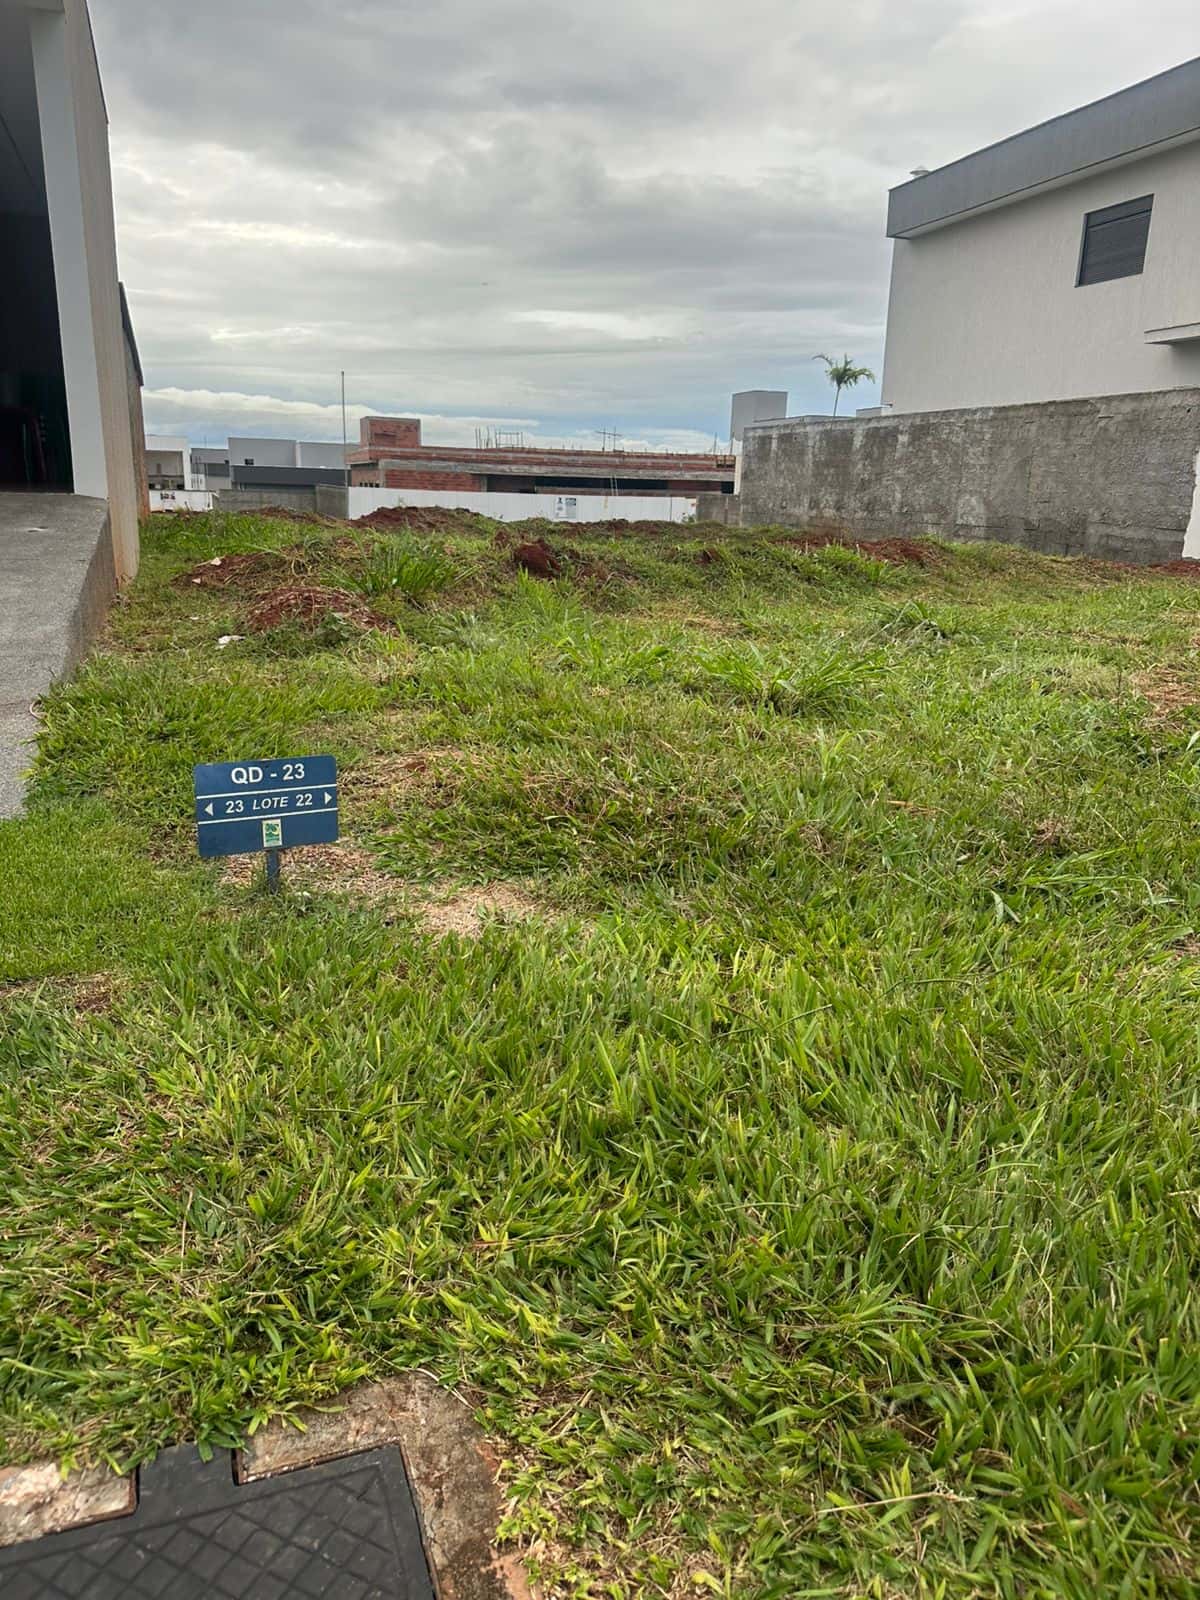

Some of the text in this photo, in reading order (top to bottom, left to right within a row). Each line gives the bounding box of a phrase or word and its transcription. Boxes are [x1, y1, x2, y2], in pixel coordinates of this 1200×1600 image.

[231, 767, 263, 784] QD
[282, 764, 305, 781] 23
[225, 793, 313, 814] 23 LOTE 22
